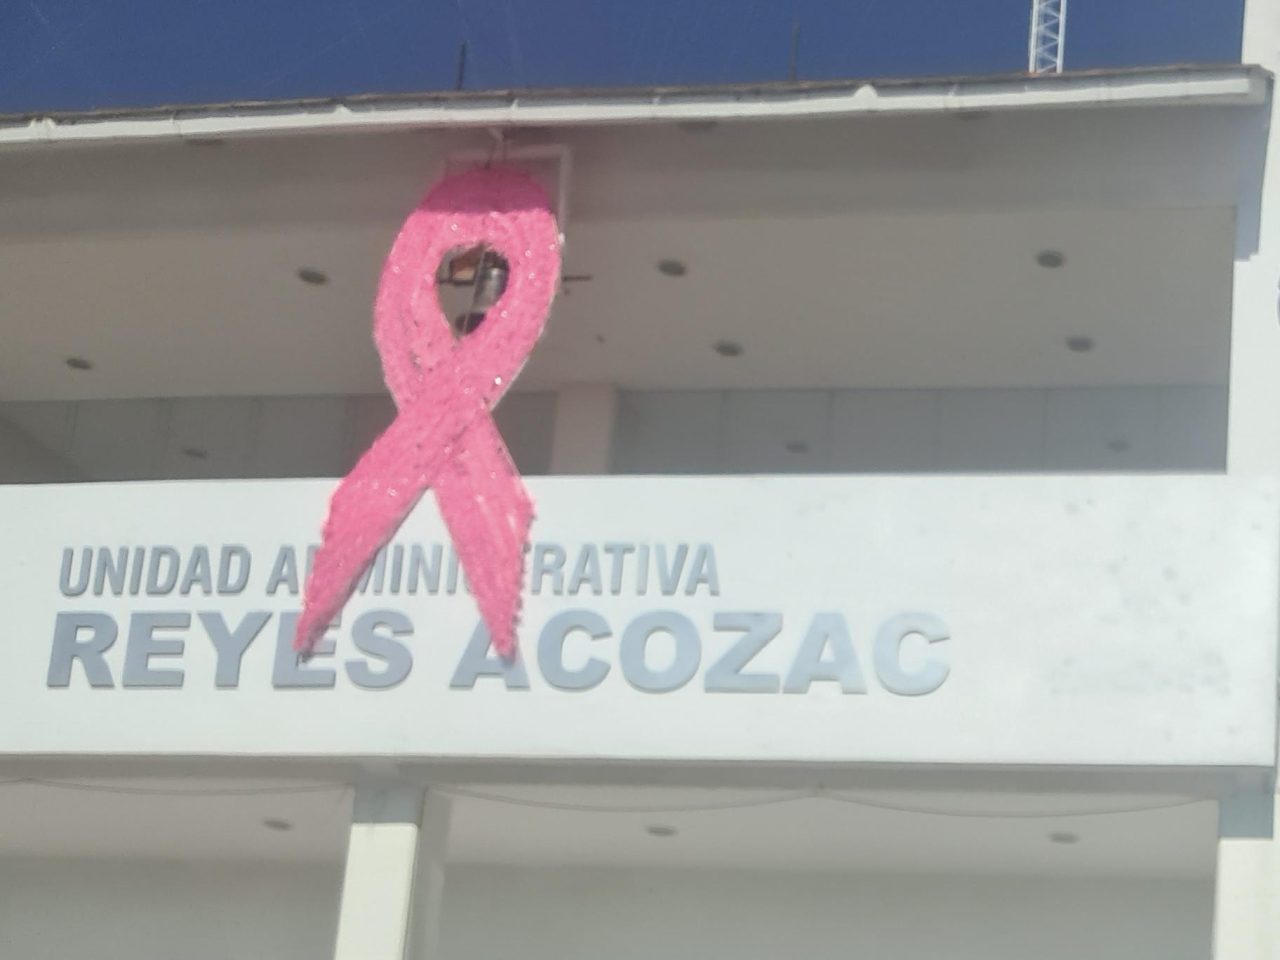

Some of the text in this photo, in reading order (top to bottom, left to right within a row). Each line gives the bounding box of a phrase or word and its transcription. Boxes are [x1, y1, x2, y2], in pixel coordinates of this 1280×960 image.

[59, 544, 251, 597] UNIDAD
[47, 609, 951, 697] REYES ACOZAC
